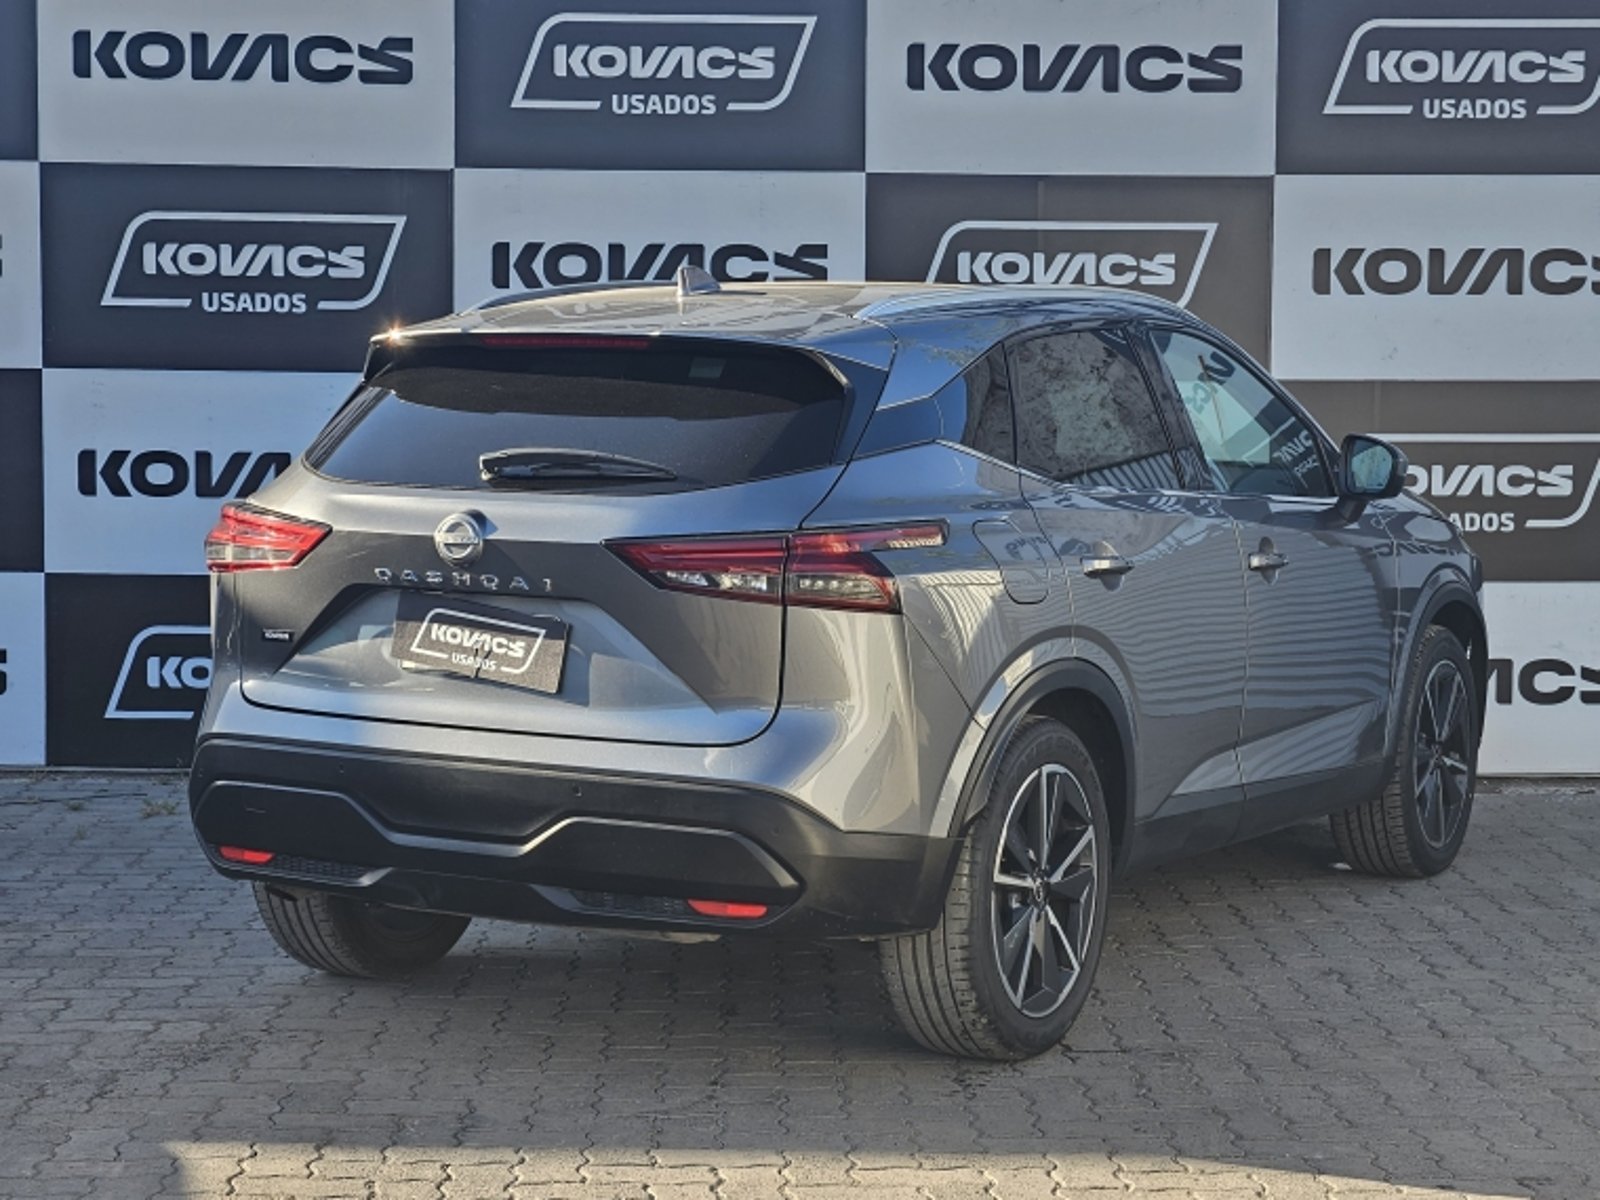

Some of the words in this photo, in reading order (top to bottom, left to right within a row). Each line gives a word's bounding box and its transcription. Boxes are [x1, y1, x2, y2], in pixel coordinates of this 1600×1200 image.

[72, 29, 413, 84] KOVACS
[553, 44, 775, 79] KOVACS
[906, 42, 1243, 93] KOVACS
[1366, 50, 1586, 83] KOVACS
[611, 94, 716, 115] USADOS
[1422, 98, 1527, 119] USADOS
[142, 242, 365, 279] KOVACS
[492, 241, 829, 289] KOVACS
[957, 251, 1176, 285] KOVACS
[1312, 248, 1600, 295] KOVAC
[201, 292, 306, 314] USADOS
[77, 448, 292, 498] KOVA
[1402, 464, 1574, 497] OVACS
[1450, 512, 1515, 532] ADOS
[373, 567, 552, 593] QASHQAI
[431, 623, 526, 658] KOVACS
